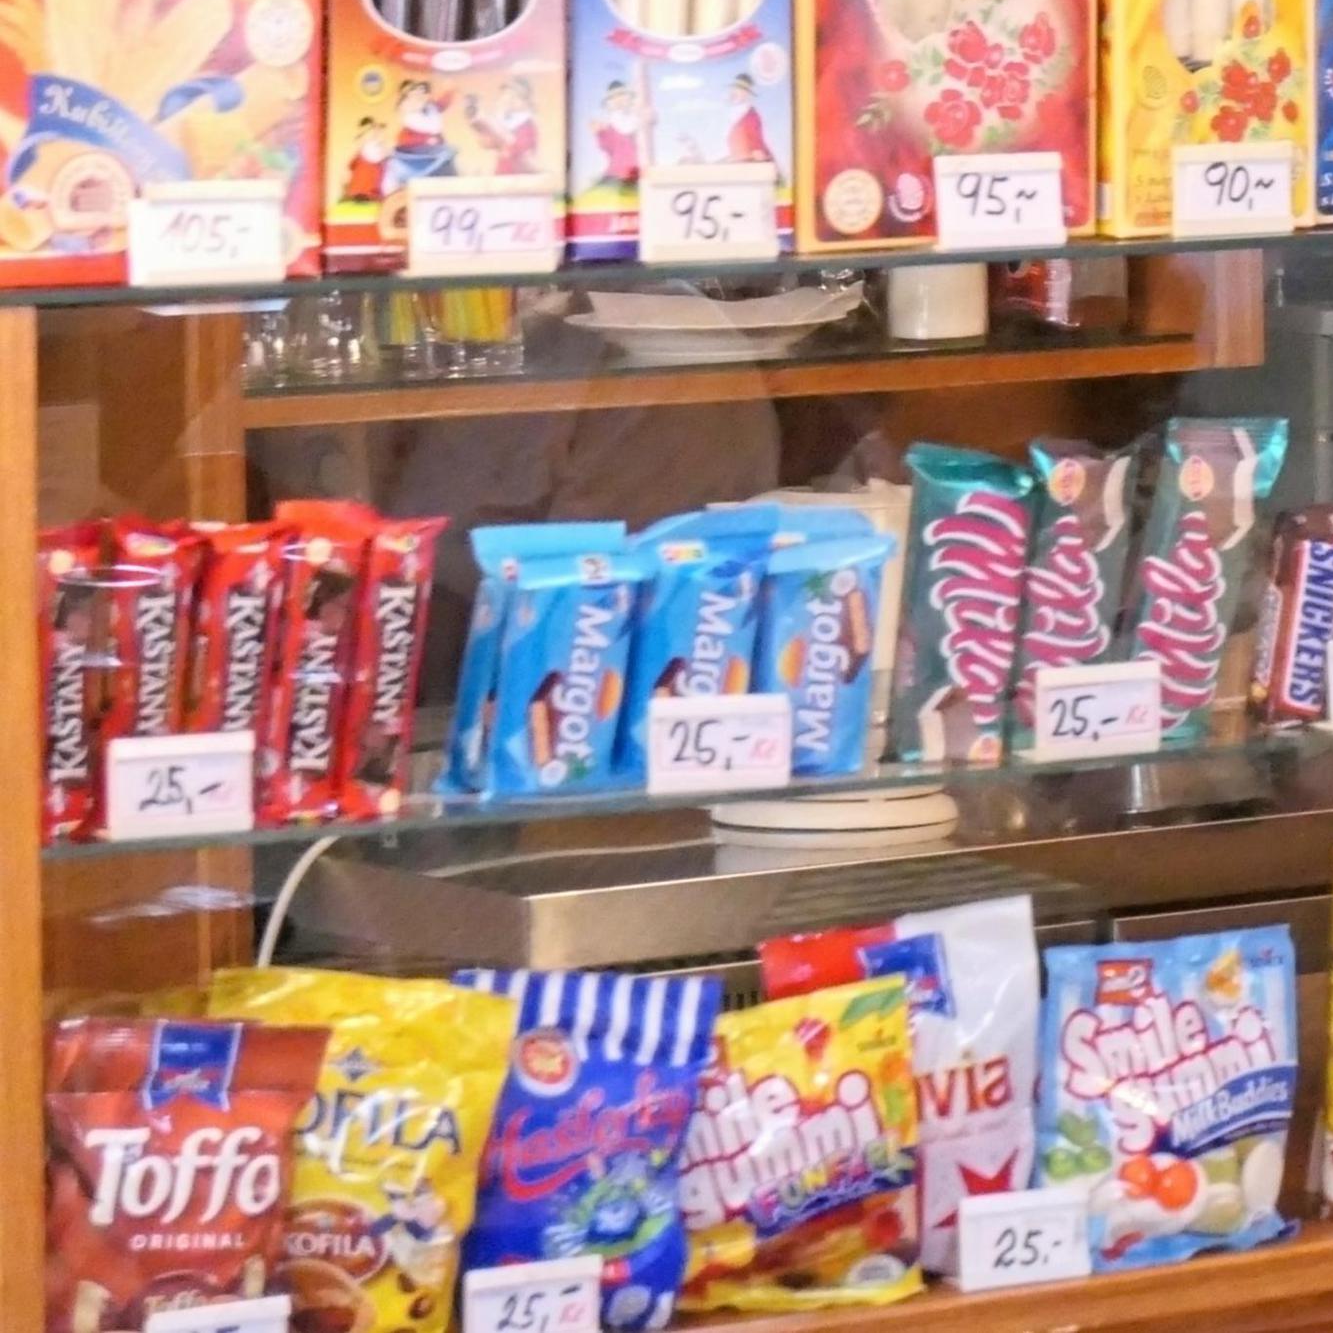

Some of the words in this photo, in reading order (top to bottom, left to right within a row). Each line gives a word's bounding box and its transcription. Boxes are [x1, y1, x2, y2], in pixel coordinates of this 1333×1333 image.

[551, 602, 613, 762] Margot
[795, 595, 850, 752] Margot
[668, 717, 751, 772] 25,-
[1049, 693, 1119, 744] 25,-
[138, 765, 223, 816] 25,-
[1059, 989, 1211, 1101] Smile
[128, 1229, 247, 1253] ORIGINAL
